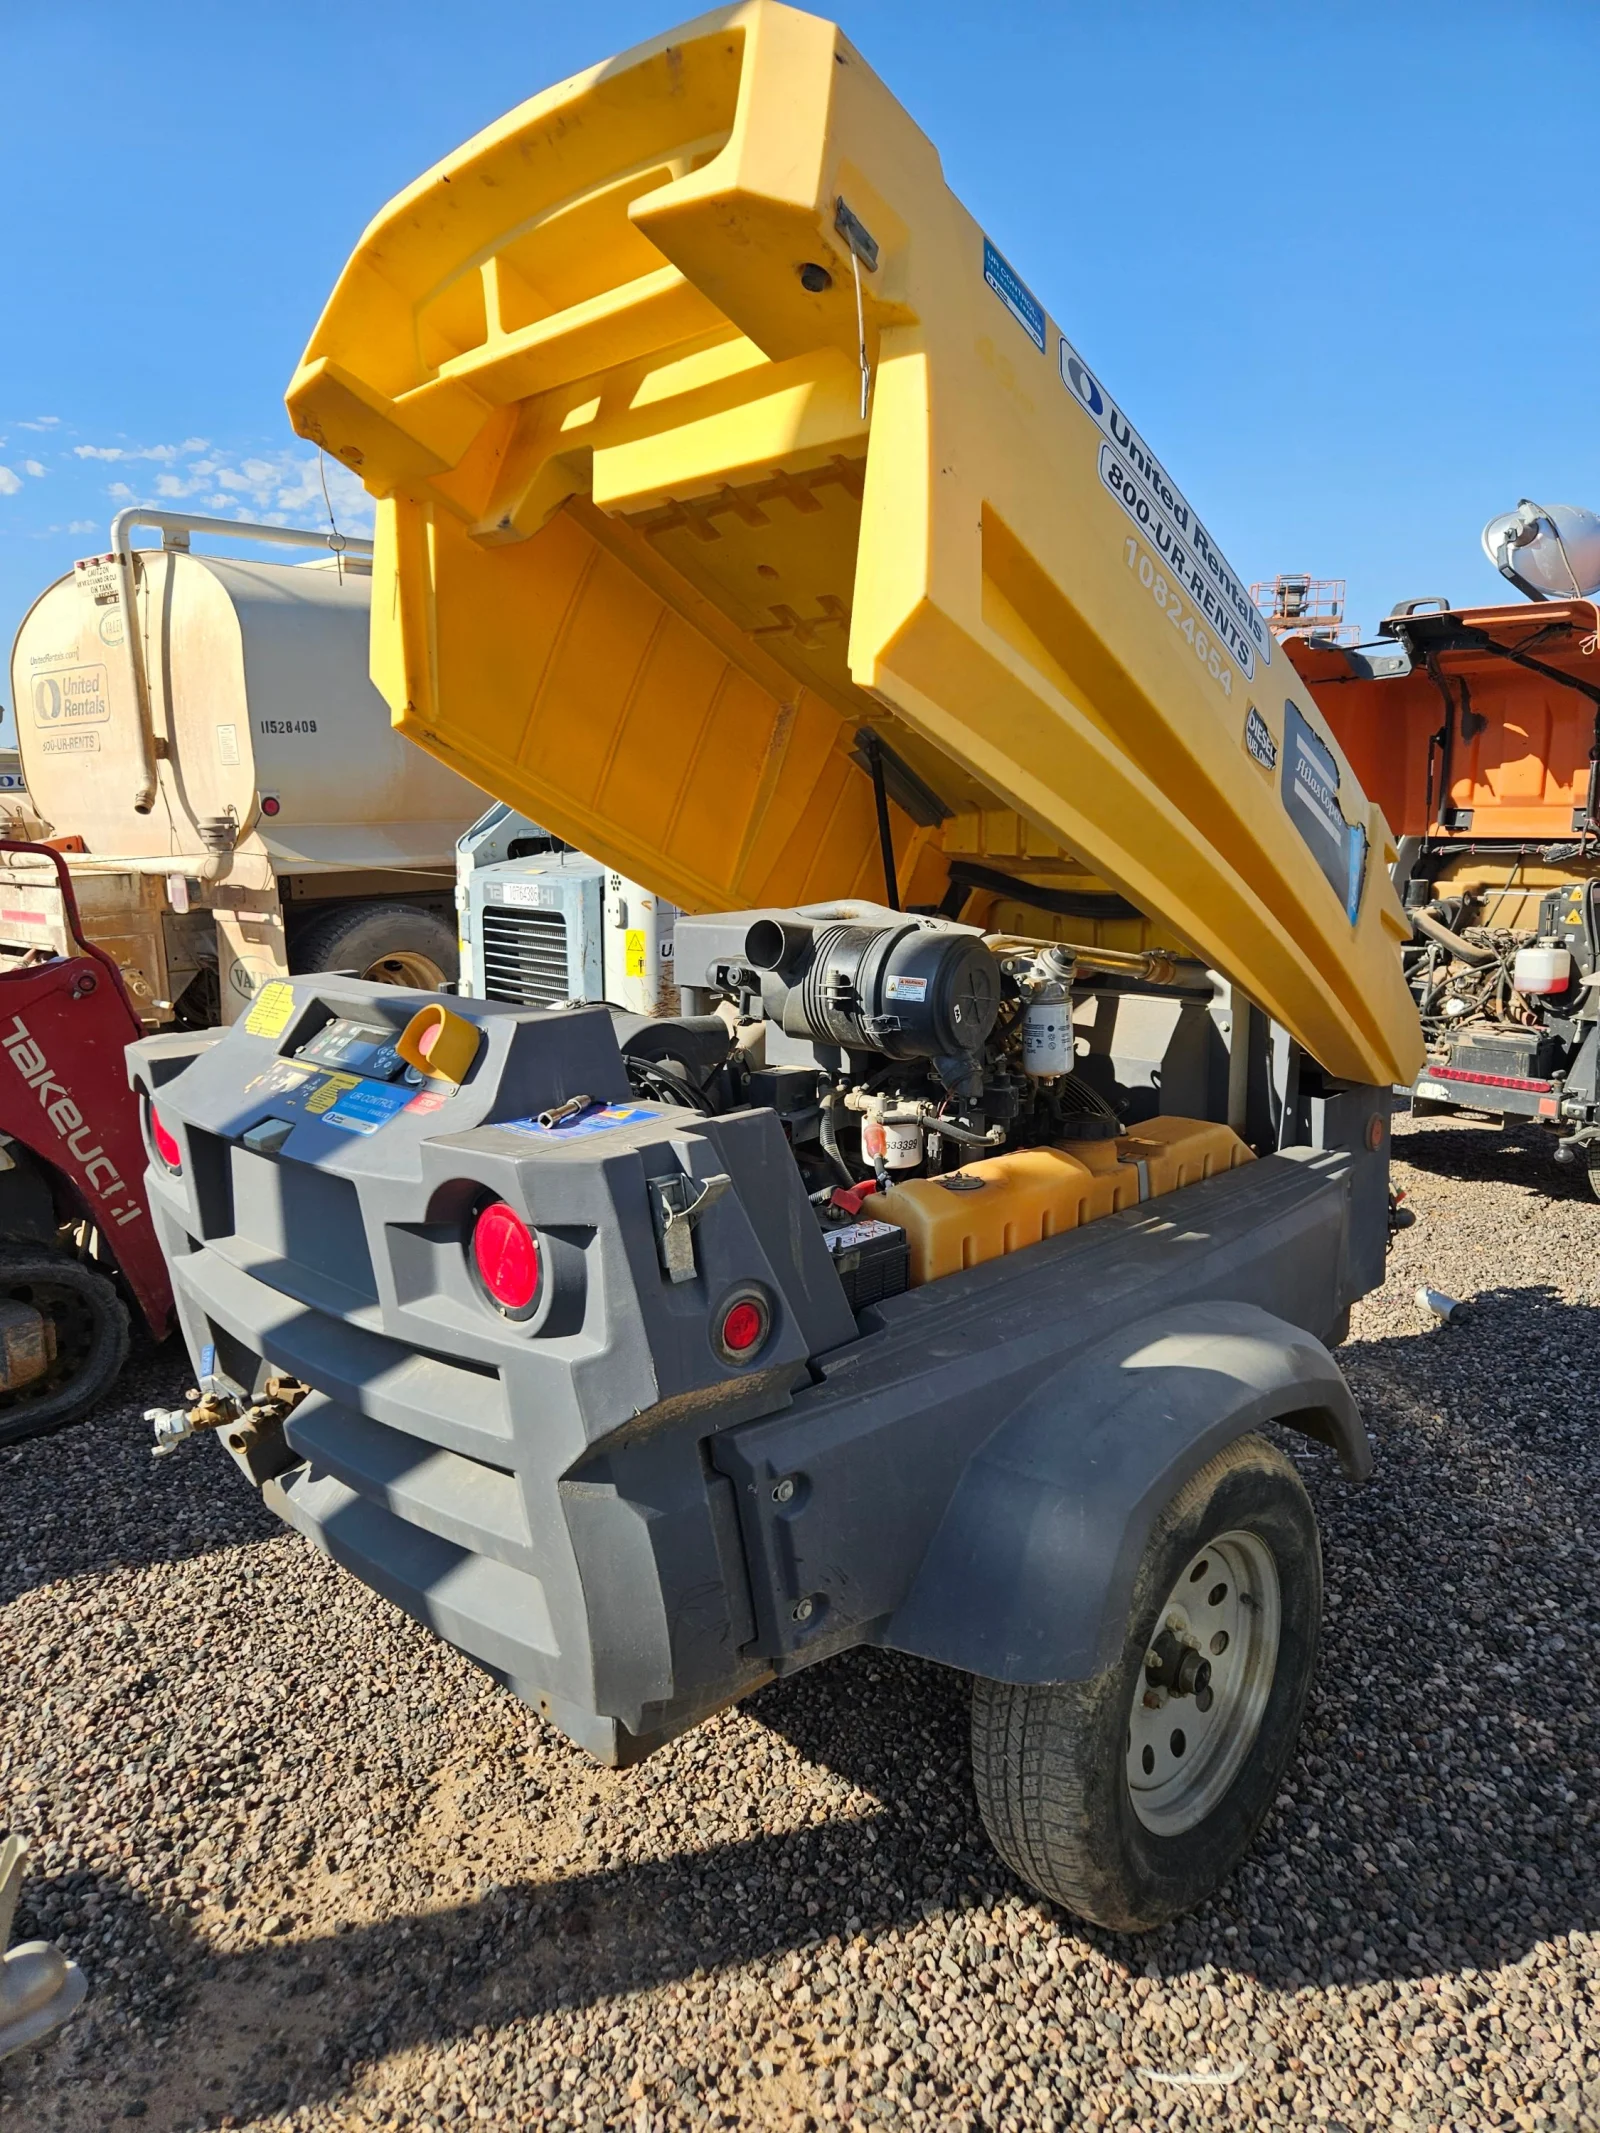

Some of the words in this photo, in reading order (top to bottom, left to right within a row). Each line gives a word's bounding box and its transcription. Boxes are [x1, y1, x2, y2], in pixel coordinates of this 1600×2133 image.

[1000, 267, 1037, 318] CONTROL
[1109, 408, 1188, 532] United
[1193, 523, 1264, 644] Rentals
[87, 566, 109, 577] CAUTION
[1107, 462, 1250, 667] 800-UR-RENTS
[99, 583, 113, 592] TANK
[1124, 537, 1233, 697] 10824654
[63, 673, 99, 696] United
[64, 695, 105, 717] Rentals
[261, 720, 317, 733] 11528409
[1248, 712, 1274, 762] DIESEL
[1296, 757, 1321, 795] Atlas
[1320, 786, 1343, 826] Copco
[361, 1094, 393, 1109] CONTROL
